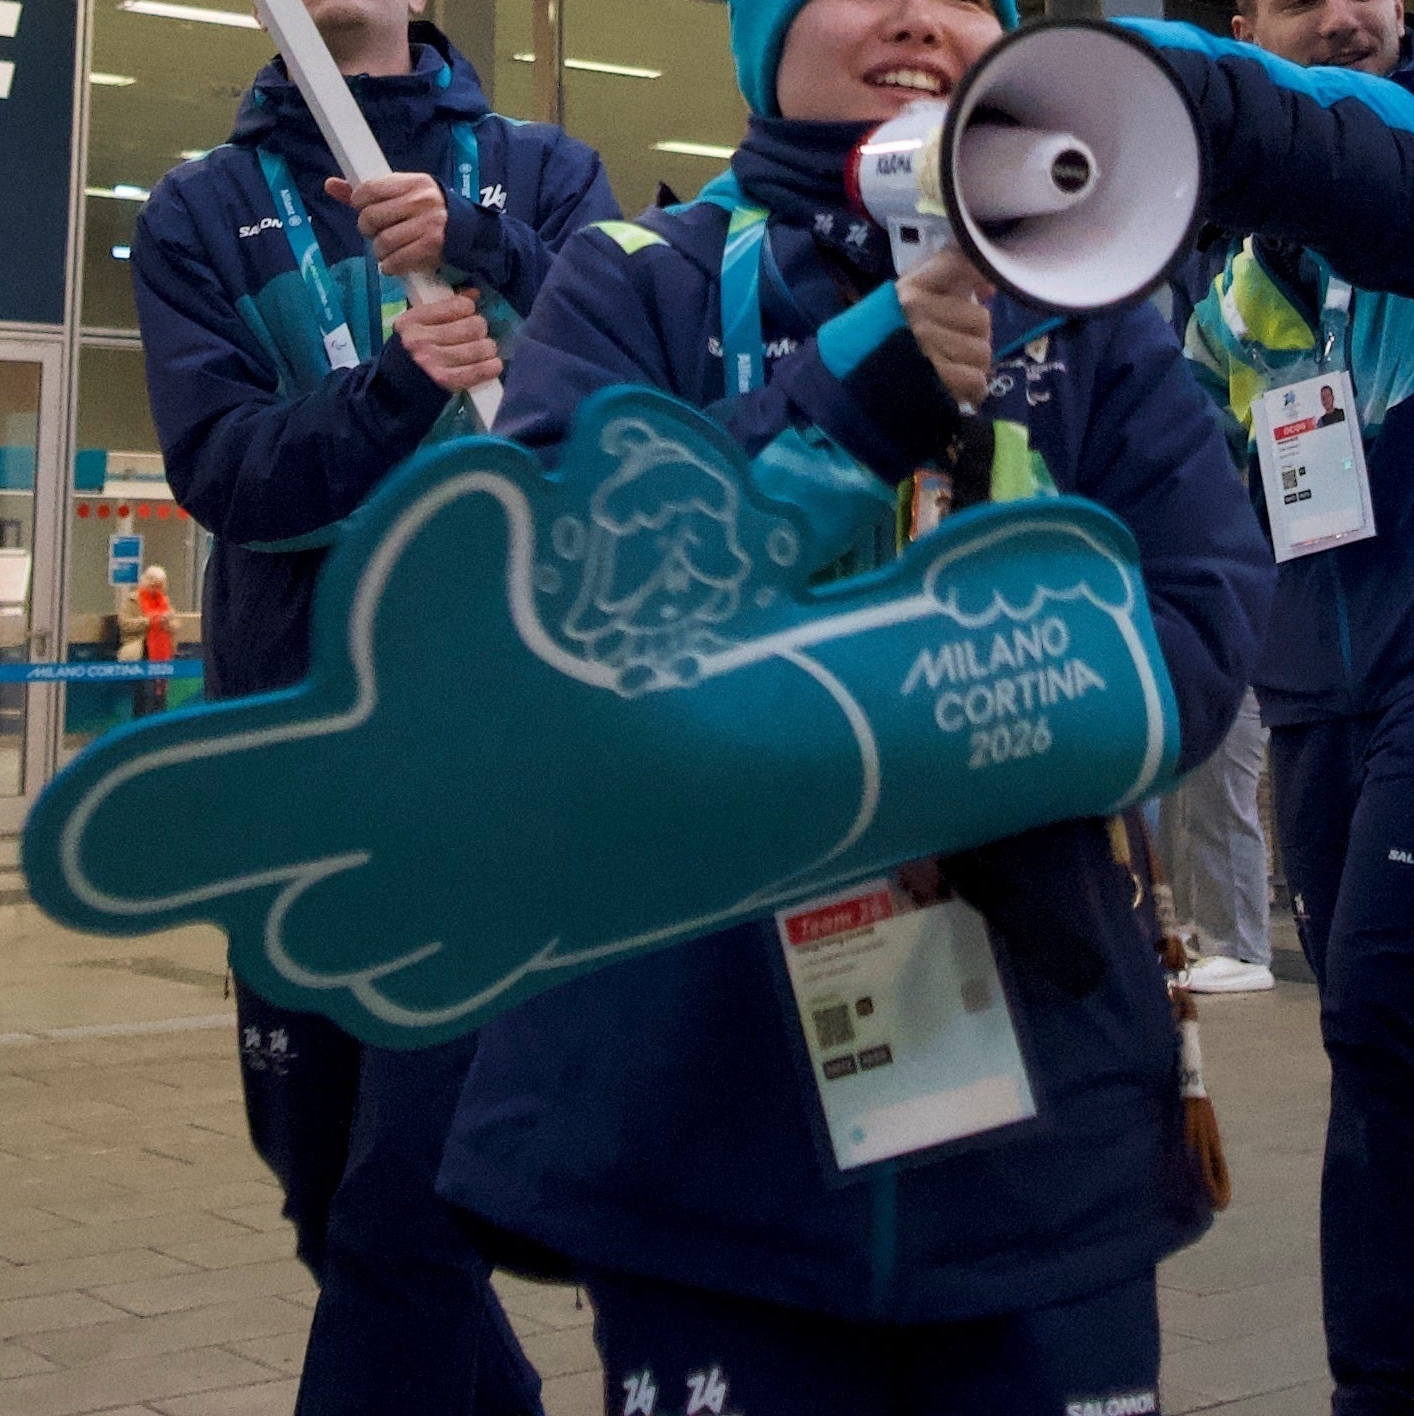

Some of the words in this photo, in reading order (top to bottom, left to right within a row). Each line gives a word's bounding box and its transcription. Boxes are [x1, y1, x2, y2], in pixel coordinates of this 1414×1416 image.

[900, 616, 1071, 697] MILANO
[933, 658, 1107, 732] CORTINA
[966, 718, 1055, 771] 2026
